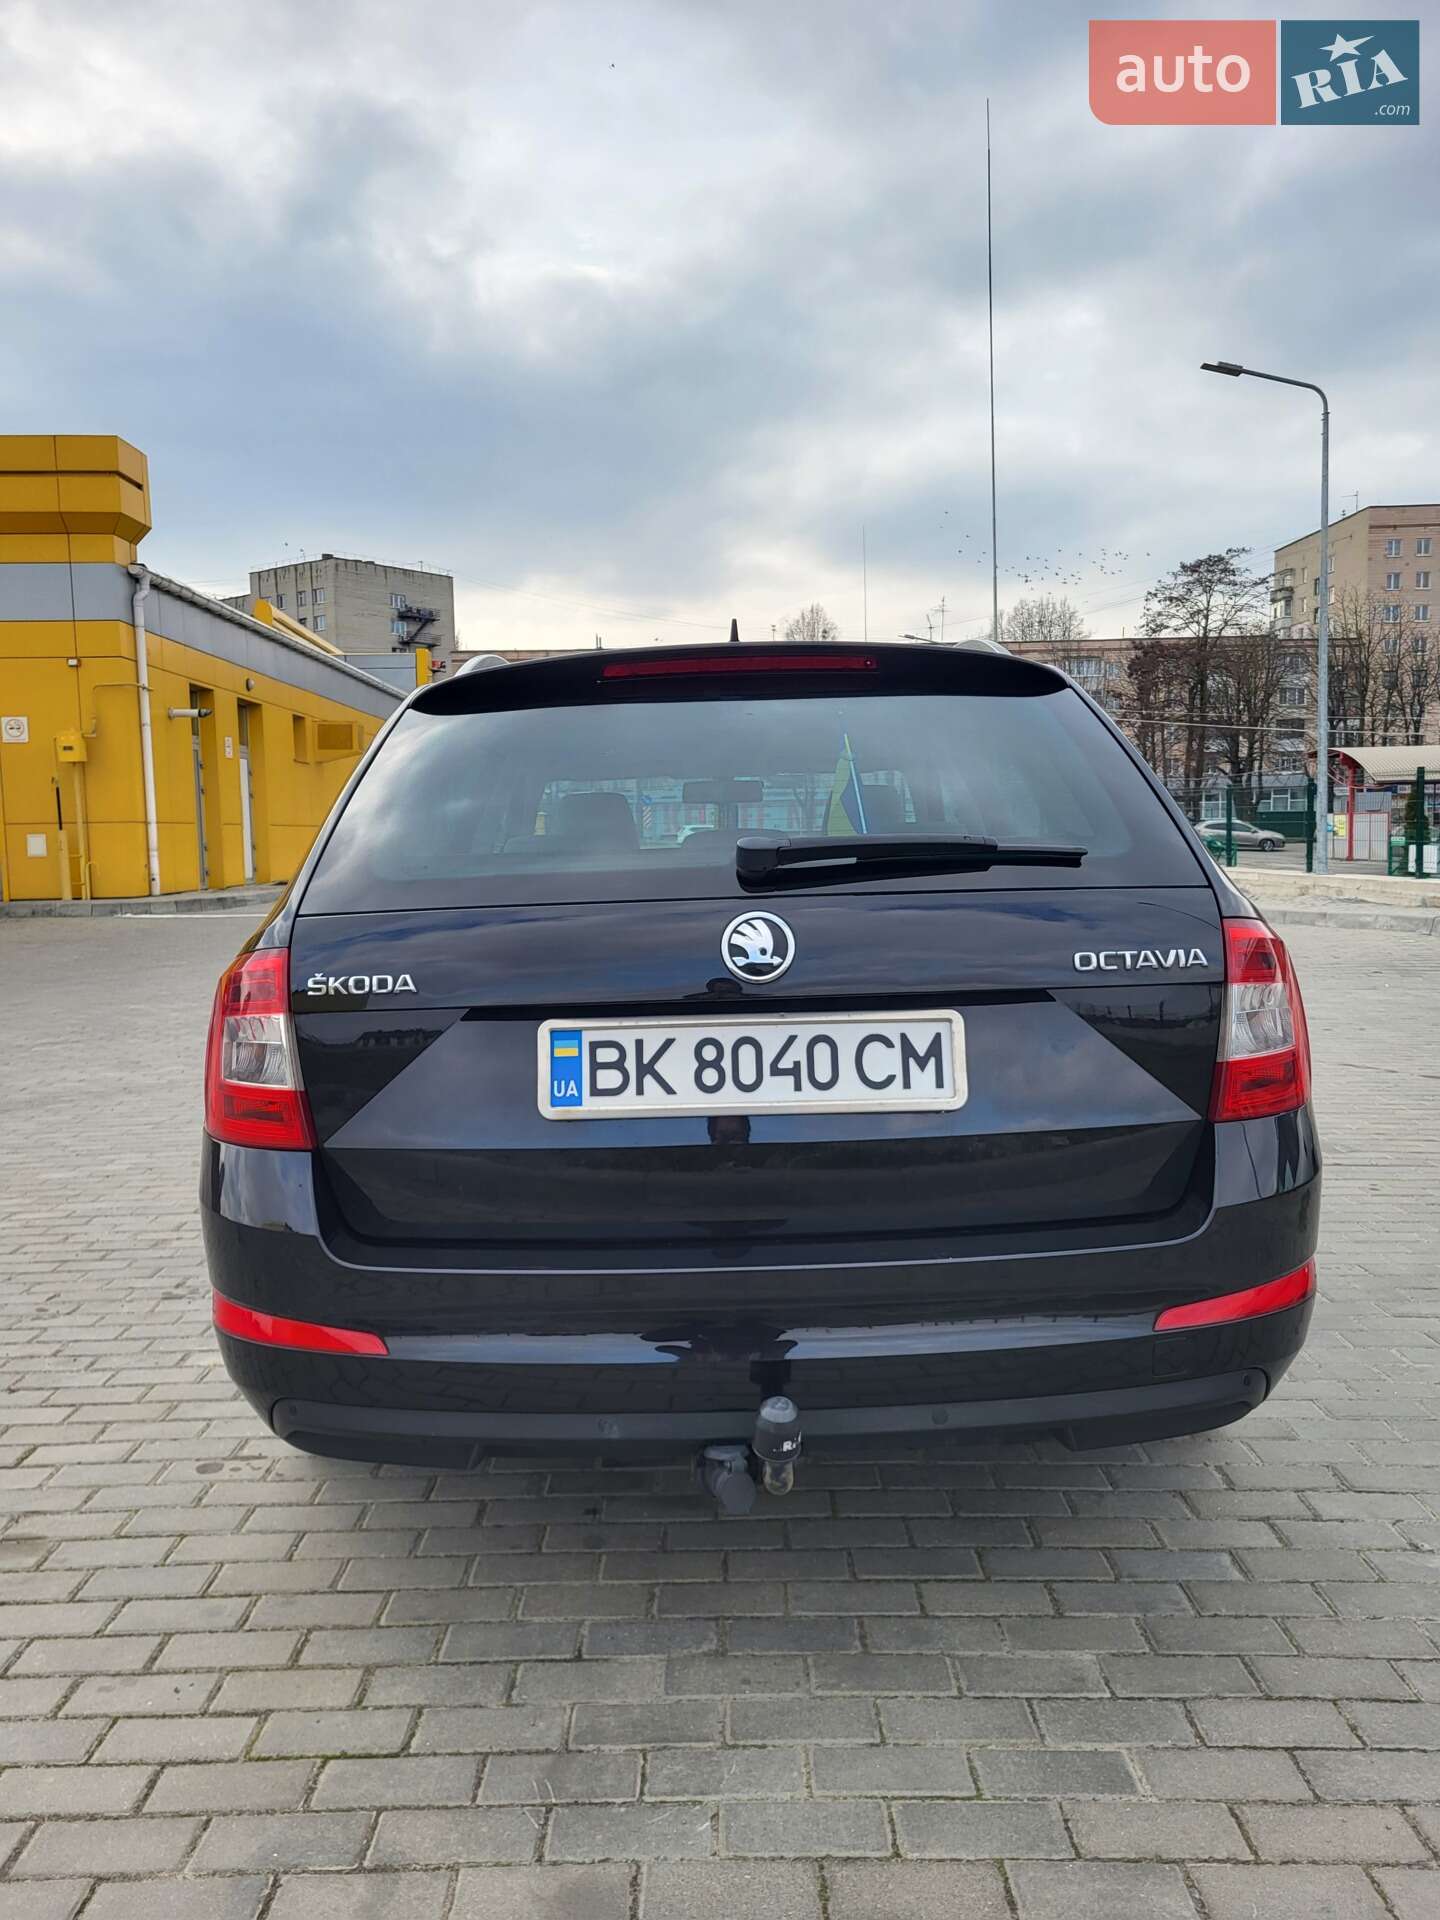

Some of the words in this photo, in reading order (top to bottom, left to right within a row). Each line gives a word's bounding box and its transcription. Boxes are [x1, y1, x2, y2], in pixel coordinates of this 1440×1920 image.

[1073, 948, 1208, 971] OCTAVIA
[307, 972, 417, 996] ŠKODA
[588, 1038, 677, 1097] BK
[694, 1033, 839, 1094] 8040
[855, 1031, 945, 1090] CM
[553, 1080, 579, 1097] UA
